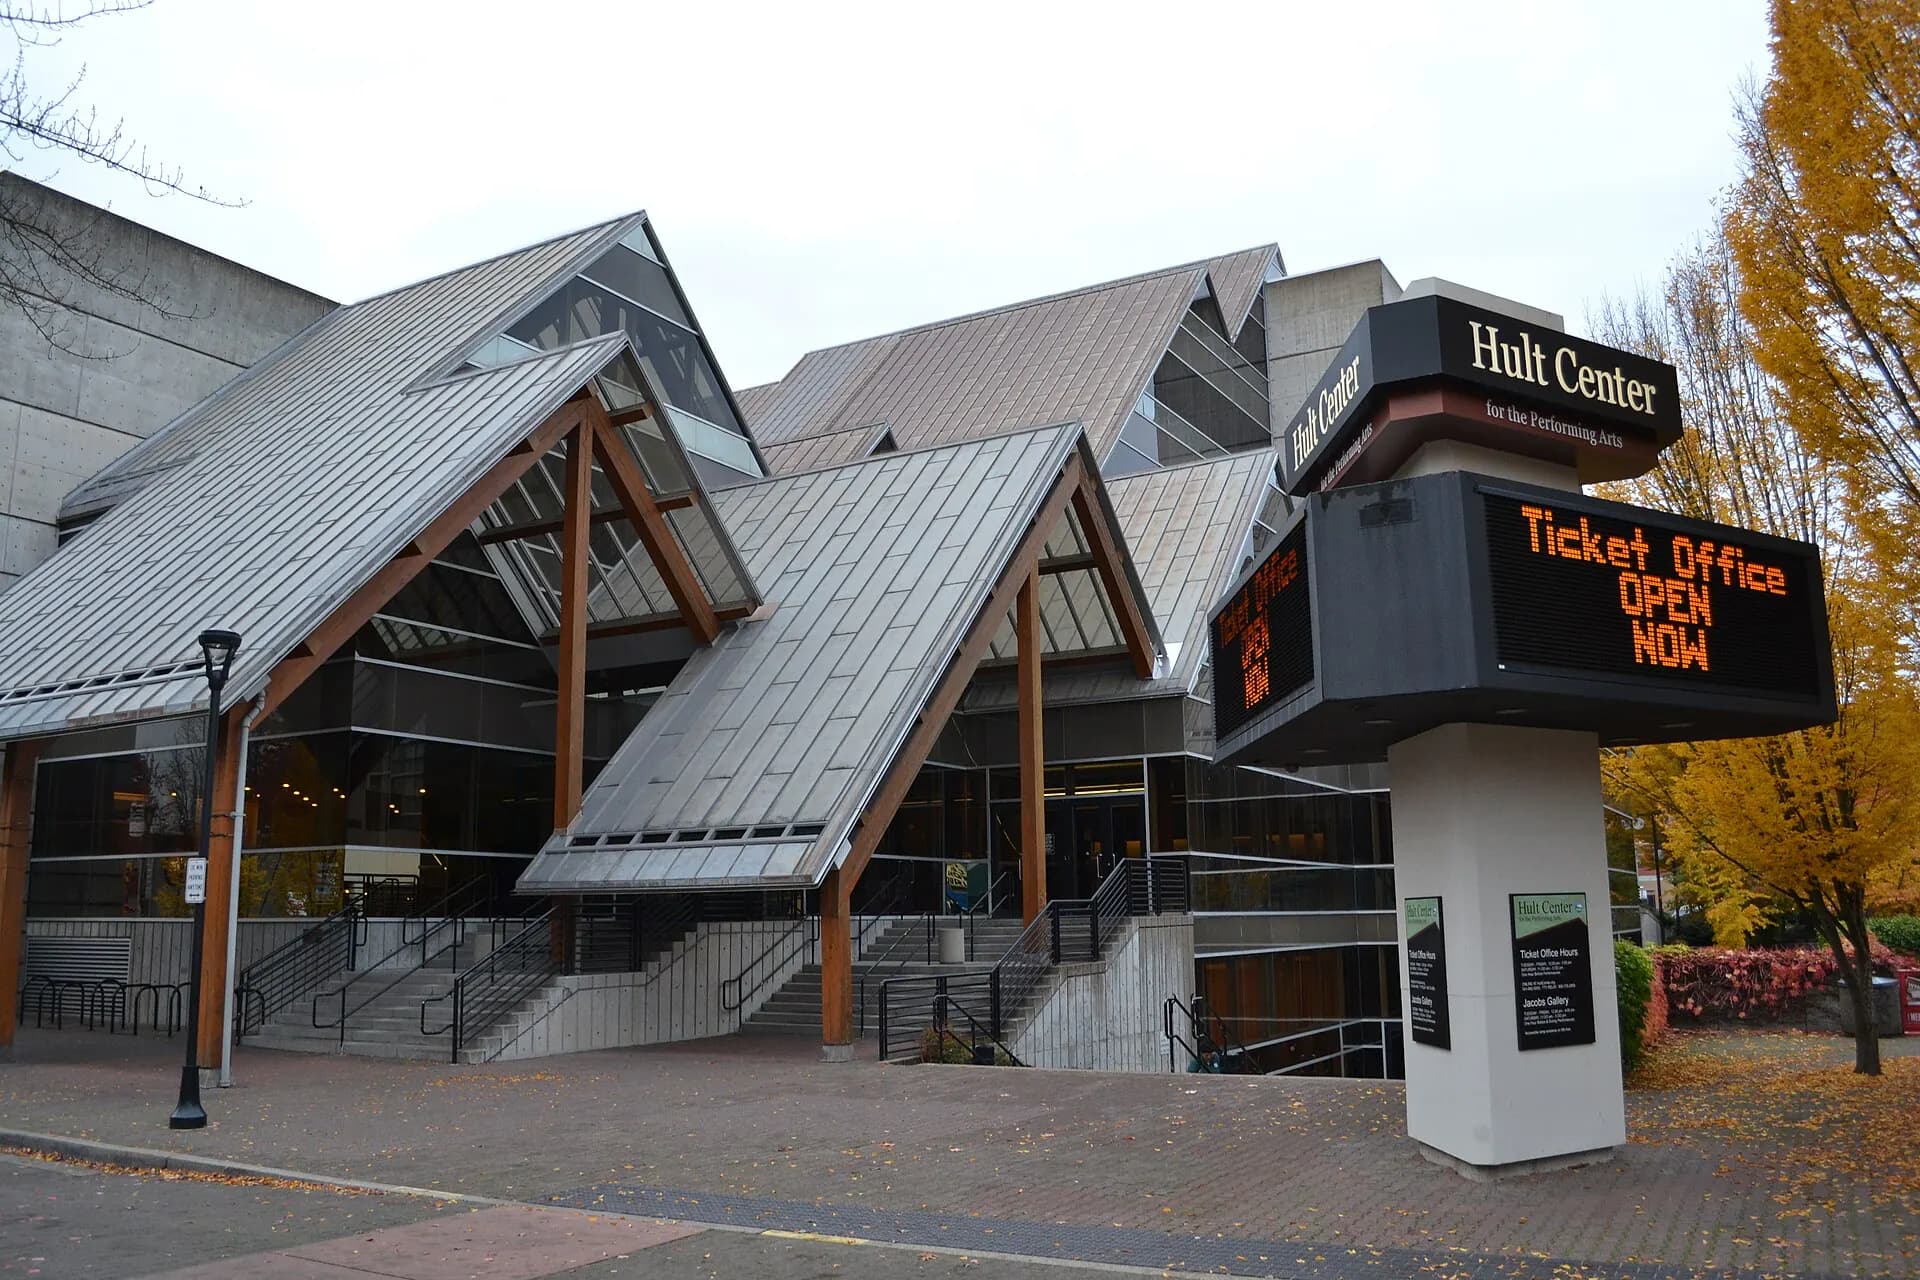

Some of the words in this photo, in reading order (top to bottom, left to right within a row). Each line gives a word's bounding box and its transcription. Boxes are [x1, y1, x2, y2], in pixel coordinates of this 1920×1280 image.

[1469, 320, 1549, 386] Hult
[1555, 347, 1656, 415] Center
[1292, 406, 1318, 472] Hult
[1319, 355, 1360, 434] Center
[1486, 398, 1504, 419] for
[1507, 404, 1528, 425] the
[1530, 410, 1597, 446] Performing
[1599, 429, 1623, 448] Arts
[1327, 467, 1335, 484] the
[1335, 438, 1362, 474] Performing
[1361, 422, 1373, 446] Arts
[1521, 504, 1649, 571] Ticket
[1672, 535, 1787, 596] Office
[1619, 571, 1712, 627] OPEN
[1241, 607, 1270, 670] OPEN
[1632, 619, 1709, 671] NOW
[1245, 656, 1270, 709] NOW
[1519, 900, 1540, 915] Hult
[1542, 901, 1573, 914] Center
[1520, 949, 1539, 959] Ticket
[1540, 948, 1559, 958] Office
[1560, 947, 1578, 957] Hours
[1523, 997, 1546, 1008] Jacobs
[1547, 996, 1569, 1007] Gallery
